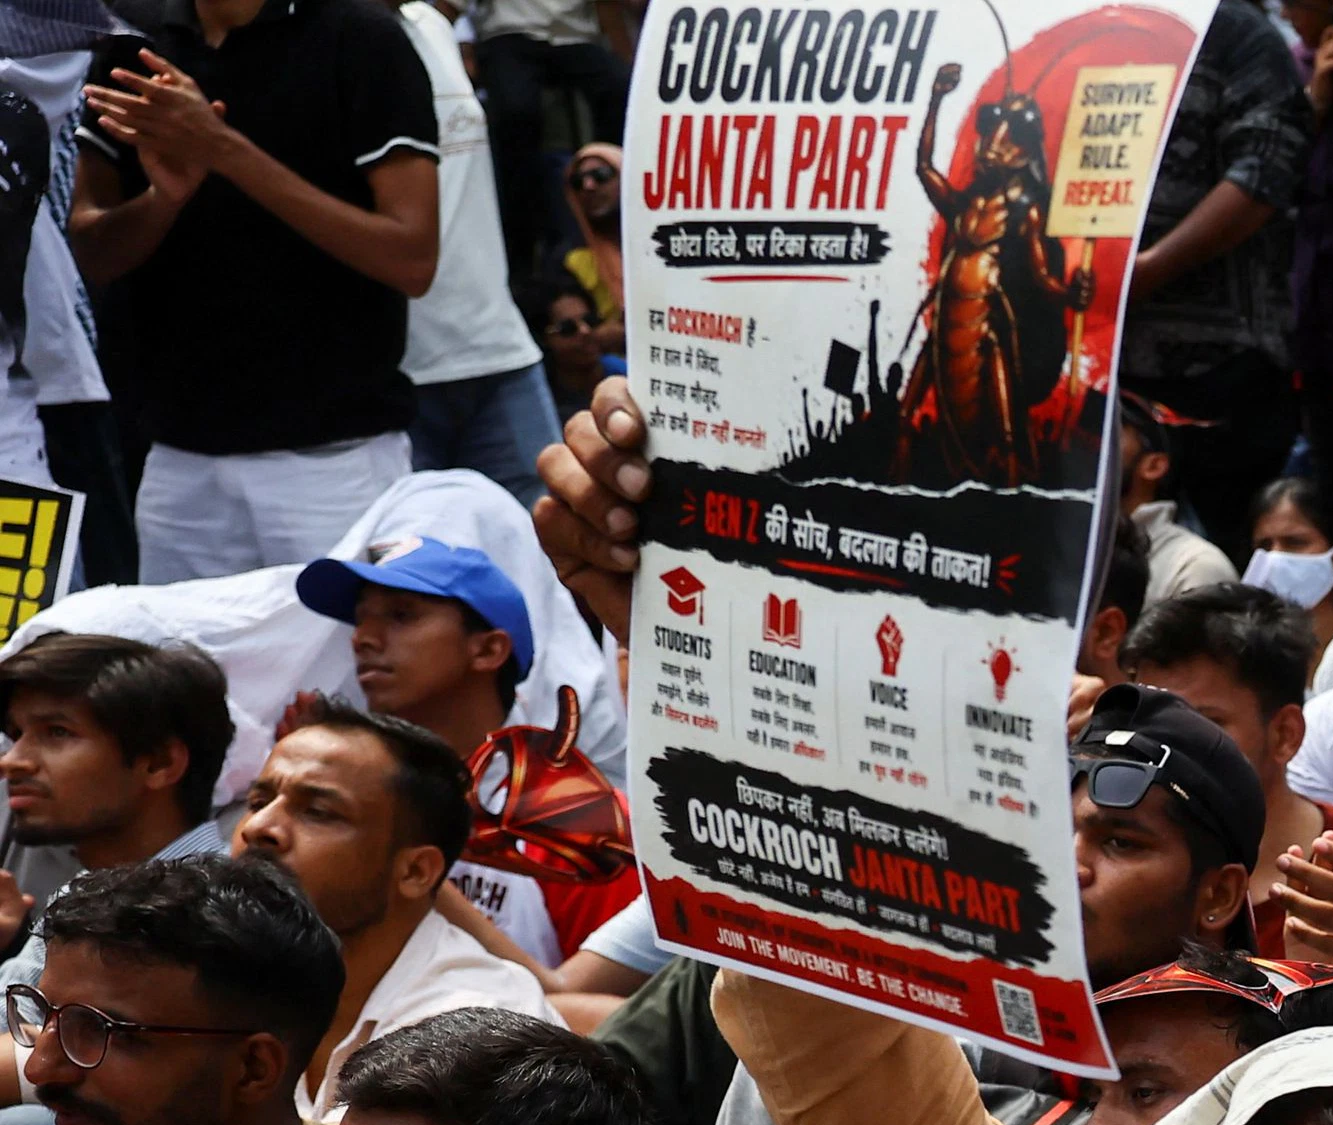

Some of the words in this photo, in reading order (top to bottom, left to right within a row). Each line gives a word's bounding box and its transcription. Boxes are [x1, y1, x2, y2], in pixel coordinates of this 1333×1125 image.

[658, 7, 938, 104] COCKROCH
[1080, 82, 1157, 107] SURVIVE.
[1080, 113, 1142, 138] ADAPT.
[643, 115, 777, 211] JANTA
[785, 115, 909, 211] PART
[1080, 145, 1130, 170] RULE.
[1063, 179, 1133, 207] REPEAT.
[669, 226, 702, 257] छोटा
[705, 226, 741, 260] दिखे,
[746, 234, 767, 257] पर
[769, 226, 806, 258] टिका
[810, 235, 848, 260] रहता
[668, 306, 742, 345] COCKROACH
[704, 489, 743, 541] GEN
[746, 500, 760, 544] Z
[765, 504, 789, 545] की
[792, 509, 834, 561] सोच,
[838, 525, 900, 569] बदलाव
[902, 532, 927, 575] की
[931, 545, 992, 589] ताकत!
[654, 625, 712, 660] STUDENTS
[749, 650, 817, 687] EDUCATION
[868, 680, 908, 711] VOICE
[965, 703, 1033, 742] INNOVATE
[735, 775, 784, 815] छिपकर
[788, 793, 819, 828] नहीं,
[822, 805, 846, 833] अब
[847, 805, 902, 848] मिलकर
[687, 797, 844, 882] COCKROCH
[848, 842, 943, 911] JANTA
[943, 868, 1022, 934] PART
[716, 927, 746, 951] JOIN
[748, 935, 776, 960] THE
[776, 943, 855, 984] MOVEMENT.
[856, 966, 877, 990] BE
[877, 972, 906, 999] THE
[907, 982, 969, 1018] CHANGE.
